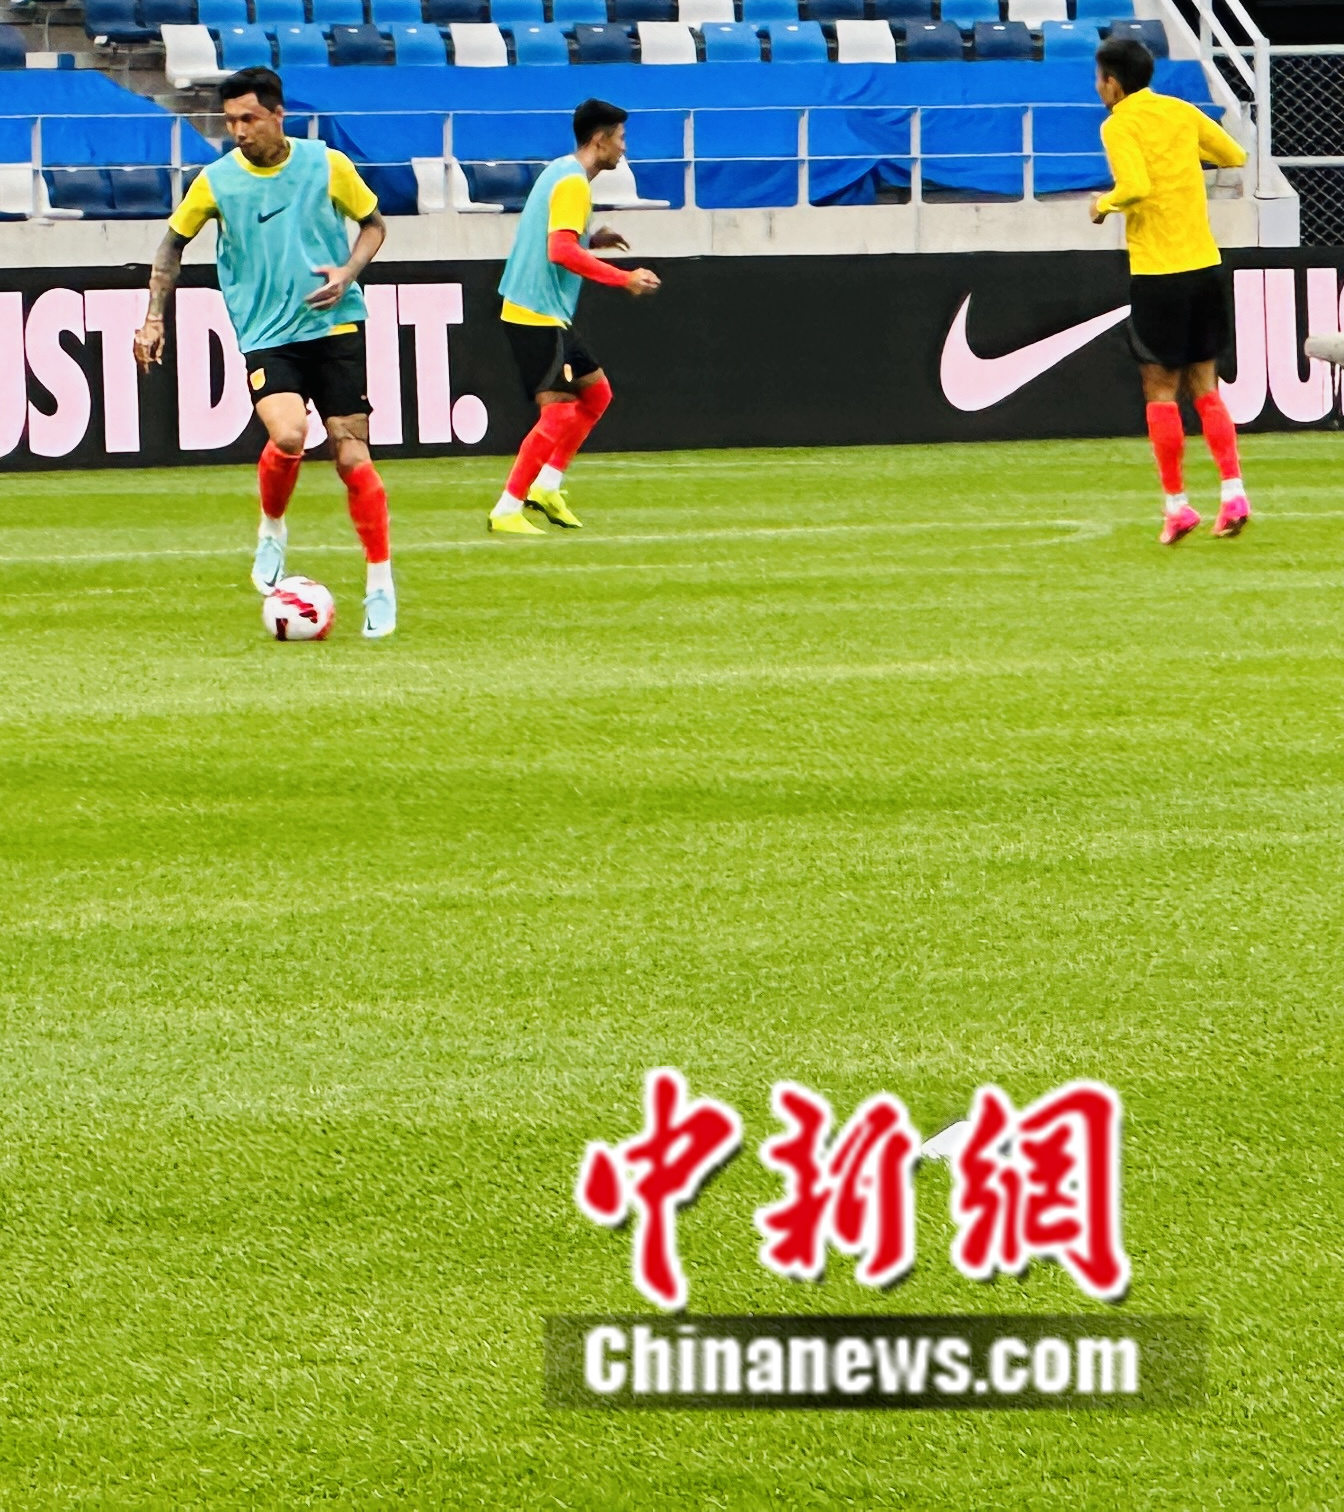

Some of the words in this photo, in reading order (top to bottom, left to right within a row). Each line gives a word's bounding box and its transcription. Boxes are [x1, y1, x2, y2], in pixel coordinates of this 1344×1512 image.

[176, 287, 328, 451] D
[365, 283, 489, 445] IT.
[1218, 267, 1344, 424] JU
